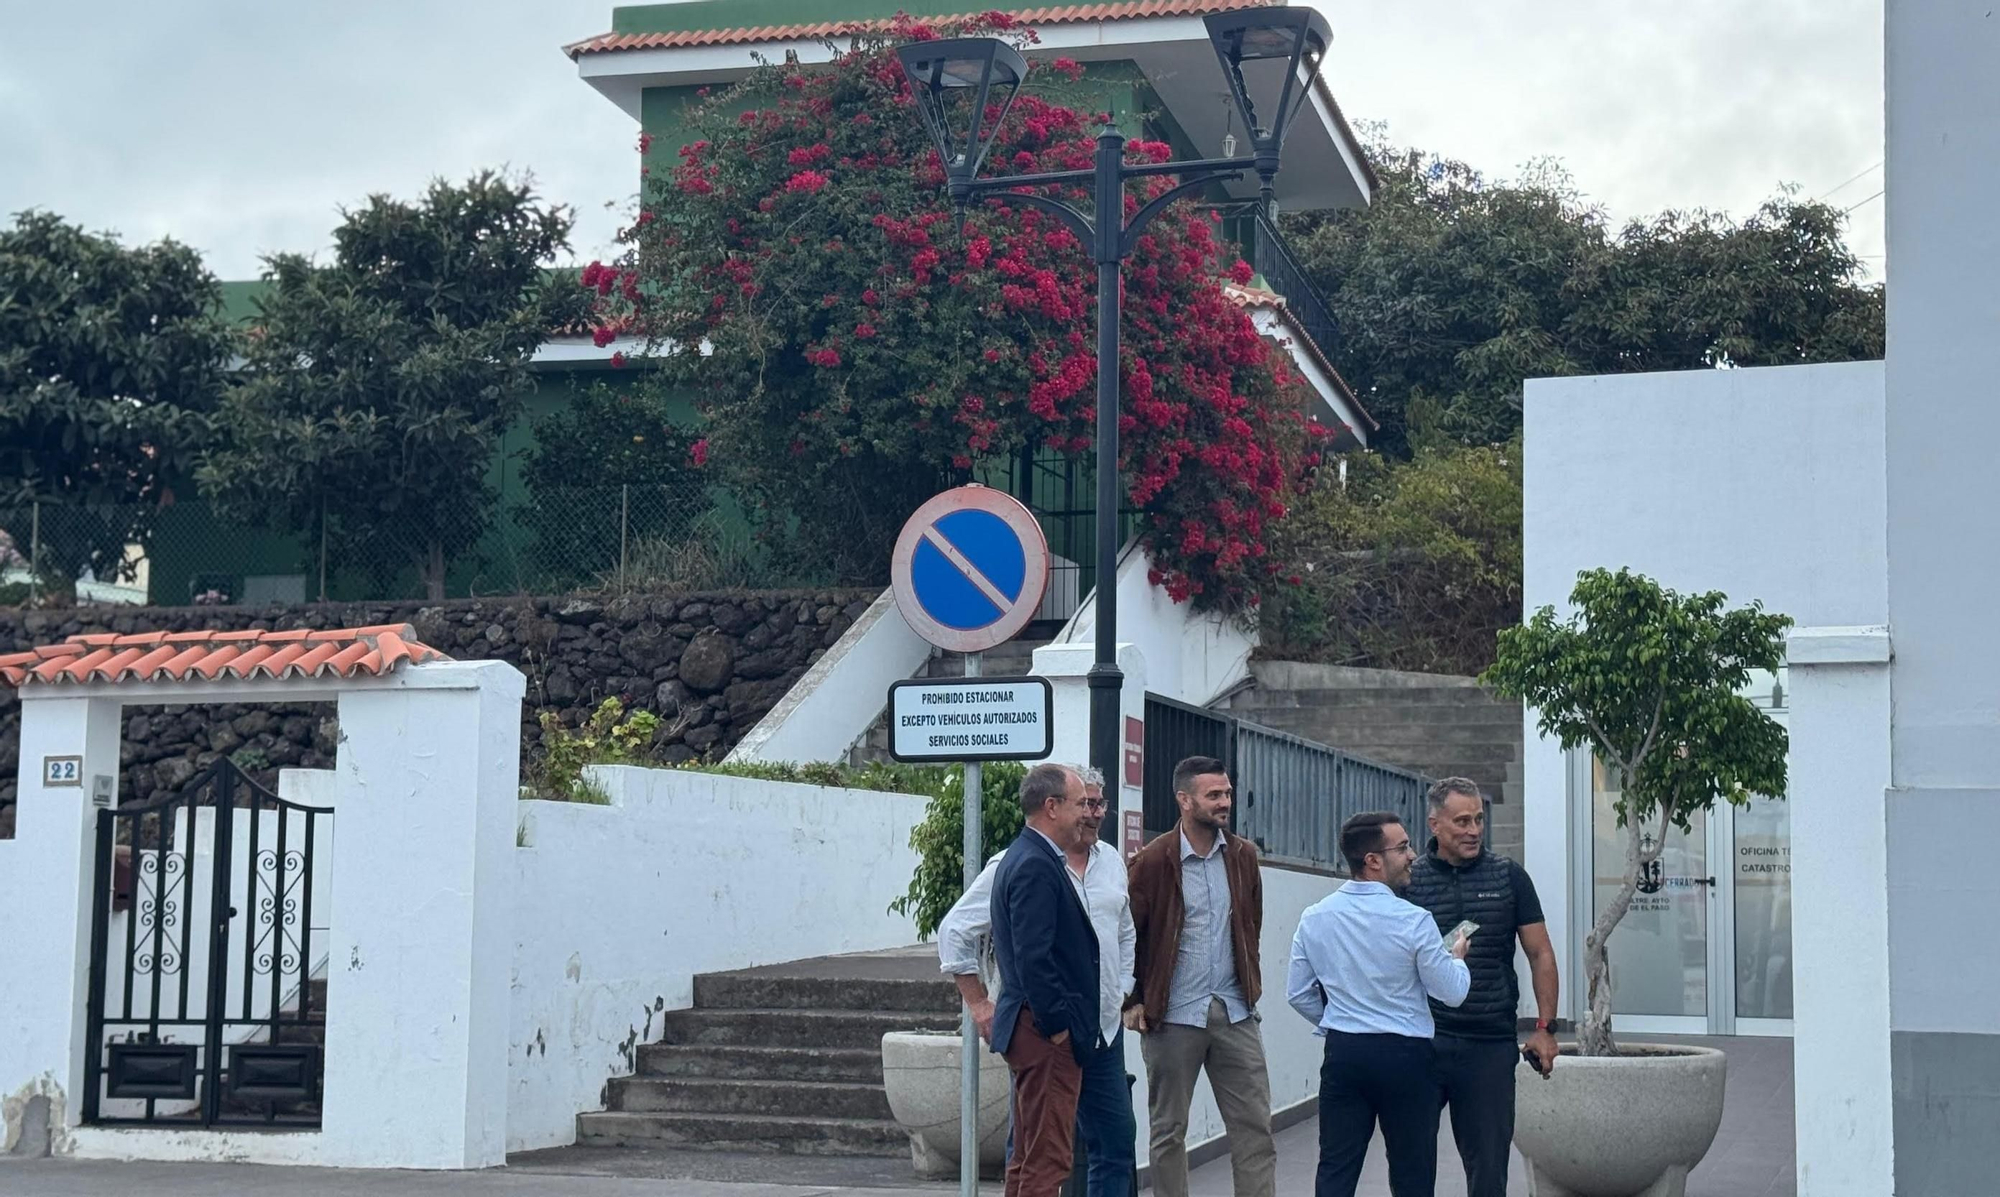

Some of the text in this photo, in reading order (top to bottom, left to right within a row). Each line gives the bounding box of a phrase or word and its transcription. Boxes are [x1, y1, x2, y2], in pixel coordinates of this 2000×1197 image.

[922, 690, 1014, 705] PROHIBIDO ESTACIONAR
[901, 711, 1037, 727] EXCEPTO VEHÍCULOS AUTORIZADOS
[928, 733, 1009, 747] SERVICIOS SOCIALES
[51, 762, 75, 779] 22
[1740, 847, 1779, 856] OFICINA
[1741, 864, 1791, 873] CATASTRO
